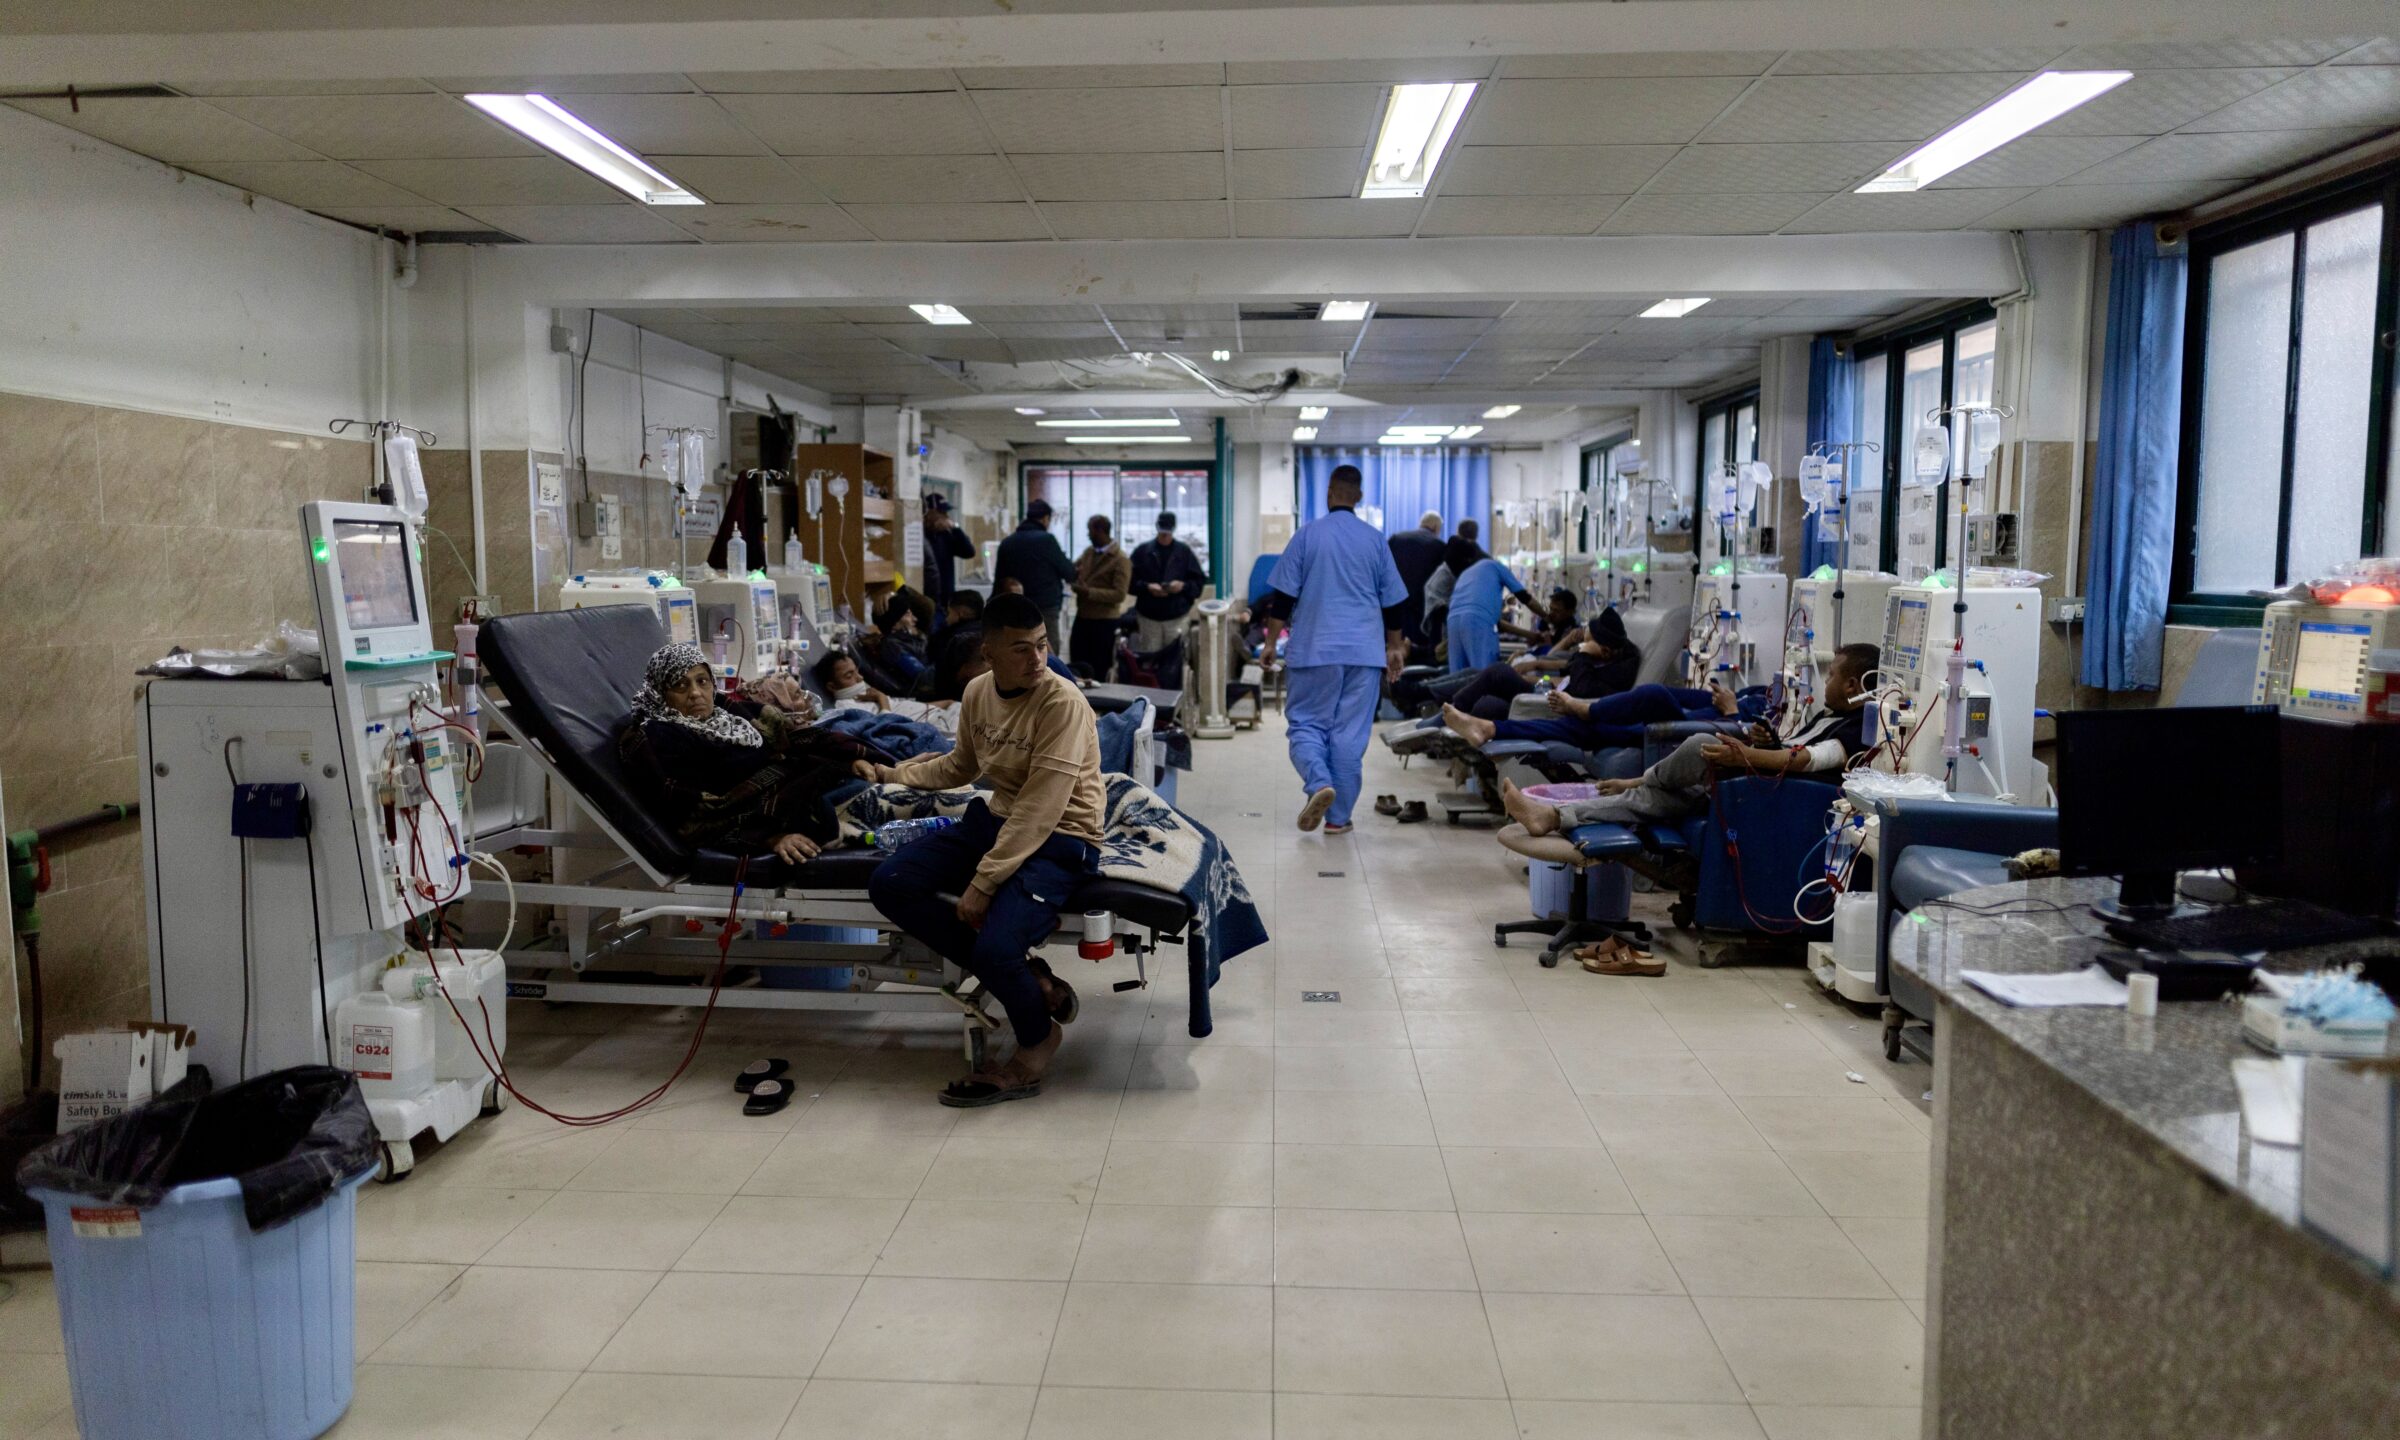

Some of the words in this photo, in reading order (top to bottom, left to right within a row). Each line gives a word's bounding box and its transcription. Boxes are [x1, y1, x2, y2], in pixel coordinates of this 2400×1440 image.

[356, 1044, 390, 1055] C924
[66, 1105, 99, 1118] Safety
[103, 1105, 122, 1116] Box
